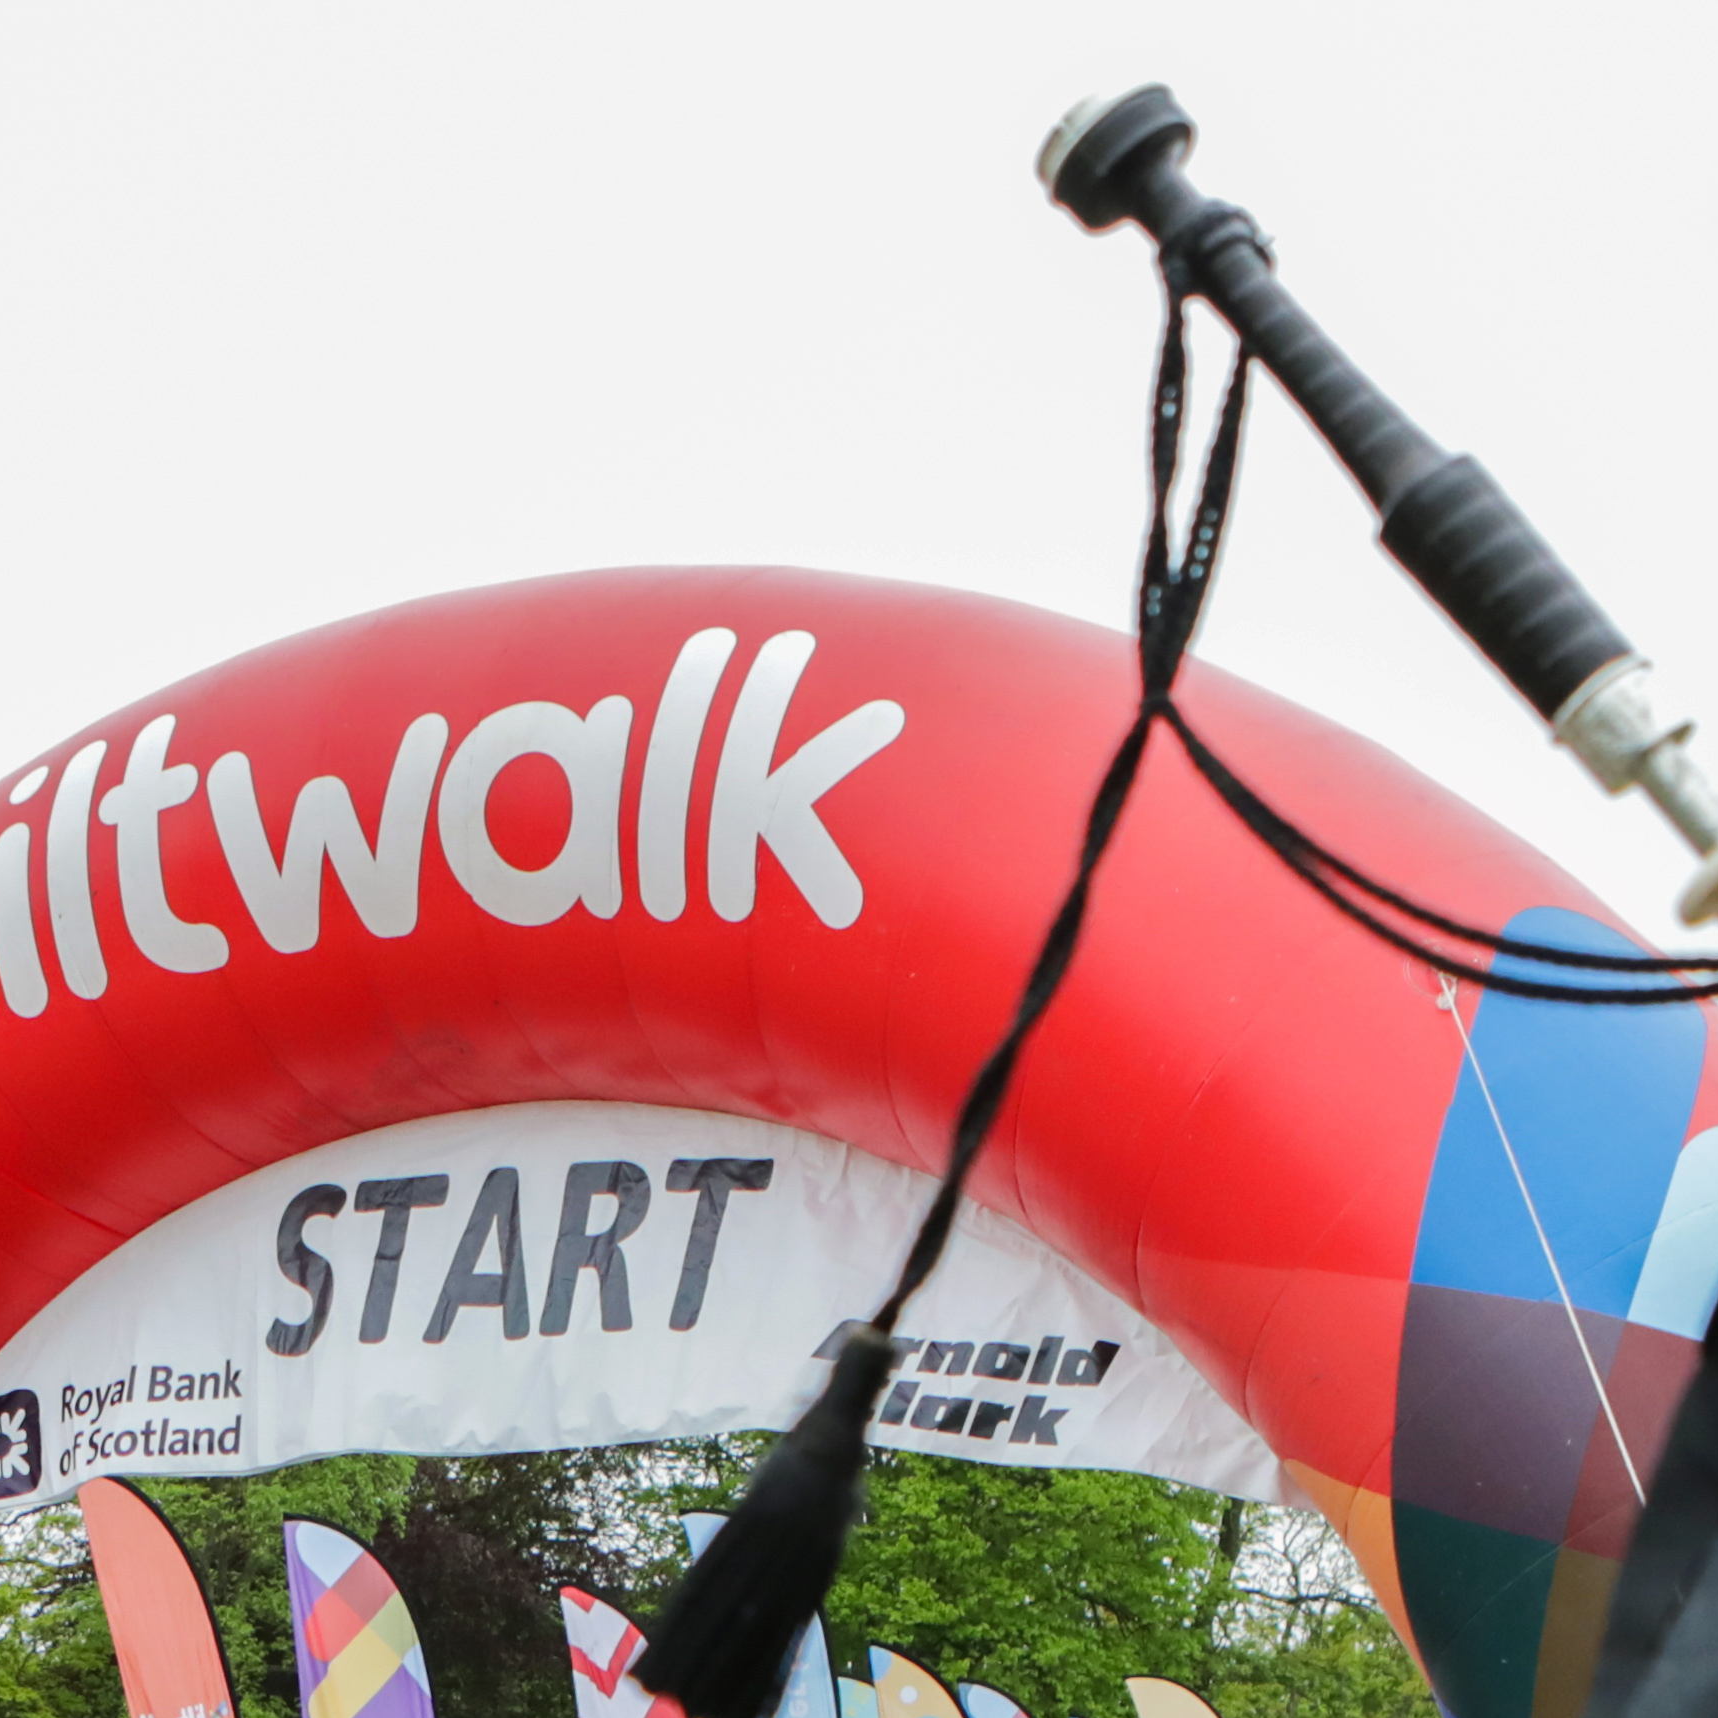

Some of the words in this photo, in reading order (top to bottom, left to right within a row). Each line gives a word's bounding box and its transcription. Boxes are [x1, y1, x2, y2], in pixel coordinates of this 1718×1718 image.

[264, 1157, 774, 1357] START
[61, 1365, 137, 1424] Royal
[147, 1359, 243, 1403] Bank
[879, 1380, 1071, 1447] lark
[59, 1430, 85, 1477] of
[86, 1414, 242, 1467] Scotland
